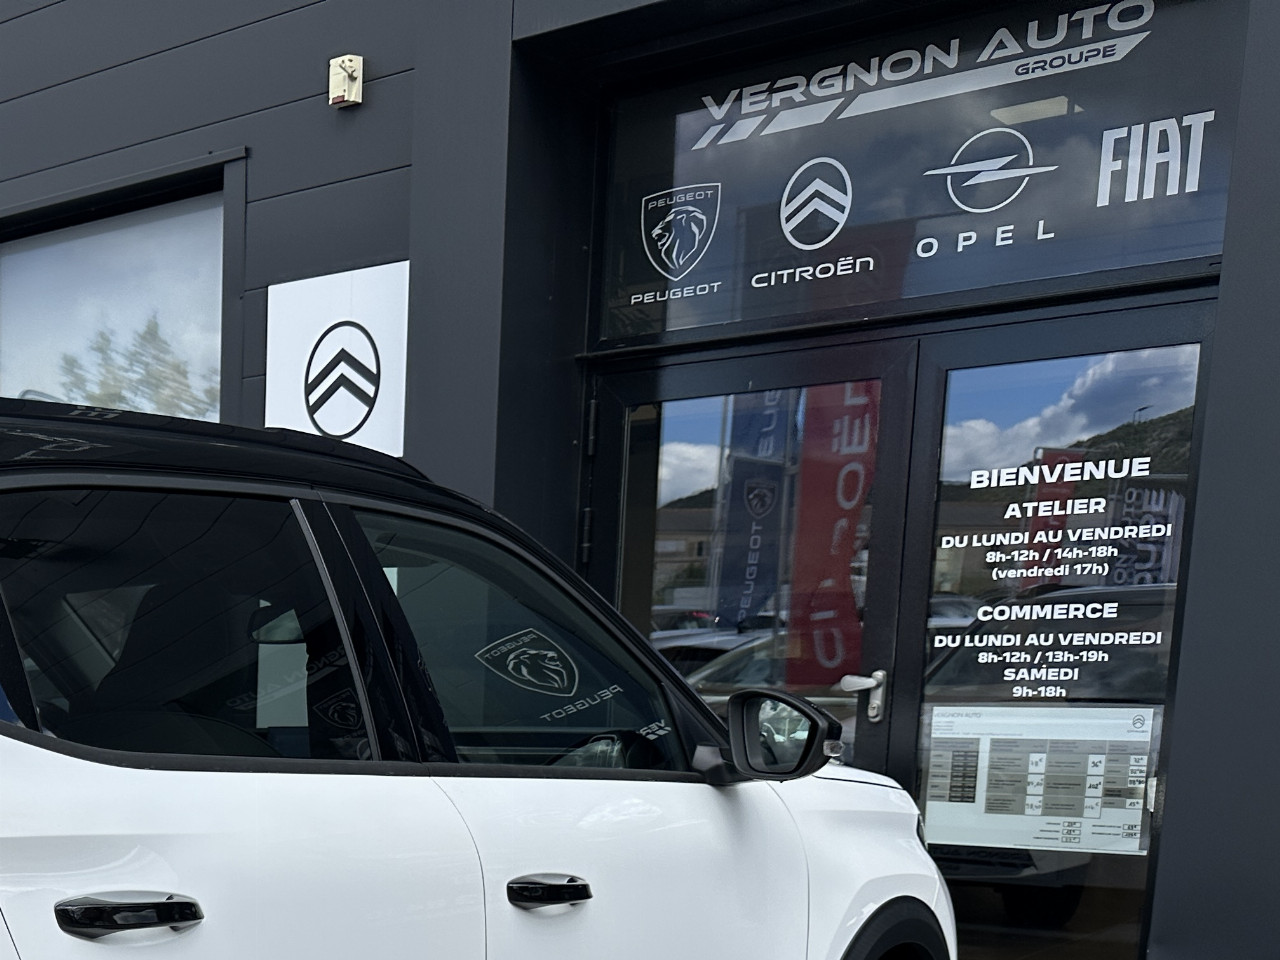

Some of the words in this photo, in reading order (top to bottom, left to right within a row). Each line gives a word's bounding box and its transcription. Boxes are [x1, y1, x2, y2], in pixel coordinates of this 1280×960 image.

[701, 38, 960, 121] VERGNON
[976, 0, 1155, 63] AUTO
[1015, 43, 1117, 76] GROUPE
[1096, 110, 1216, 208] FIAT
[648, 190, 713, 210] PEUGEOT
[915, 219, 1055, 259] OPEL
[630, 281, 722, 305] PEUGEOT
[970, 456, 1152, 489] BIENVENUE
[1004, 497, 1107, 519] ATELIER
[941, 536, 968, 549] DU
[972, 532, 1029, 547] LUNDI
[1033, 529, 1063, 543] AU
[1067, 523, 1173, 542] VENDREDI
[985, 548, 1040, 563] 8h-12h
[1053, 545, 1119, 560] 14h-18h
[992, 563, 1070, 580] (vendredi
[1073, 562, 1110, 577] 17h)
[977, 602, 1119, 621] COMMERCE
[934, 635, 961, 648] DU
[964, 634, 1021, 647] LUNDI
[1024, 633, 1054, 646] AU
[1058, 631, 1163, 645] VENDREDI
[977, 651, 1031, 664] 8h-12h
[1045, 650, 1109, 663] 13h-19h
[1003, 667, 1079, 681] SAMEDI
[1012, 685, 1067, 698] 9h-18h
